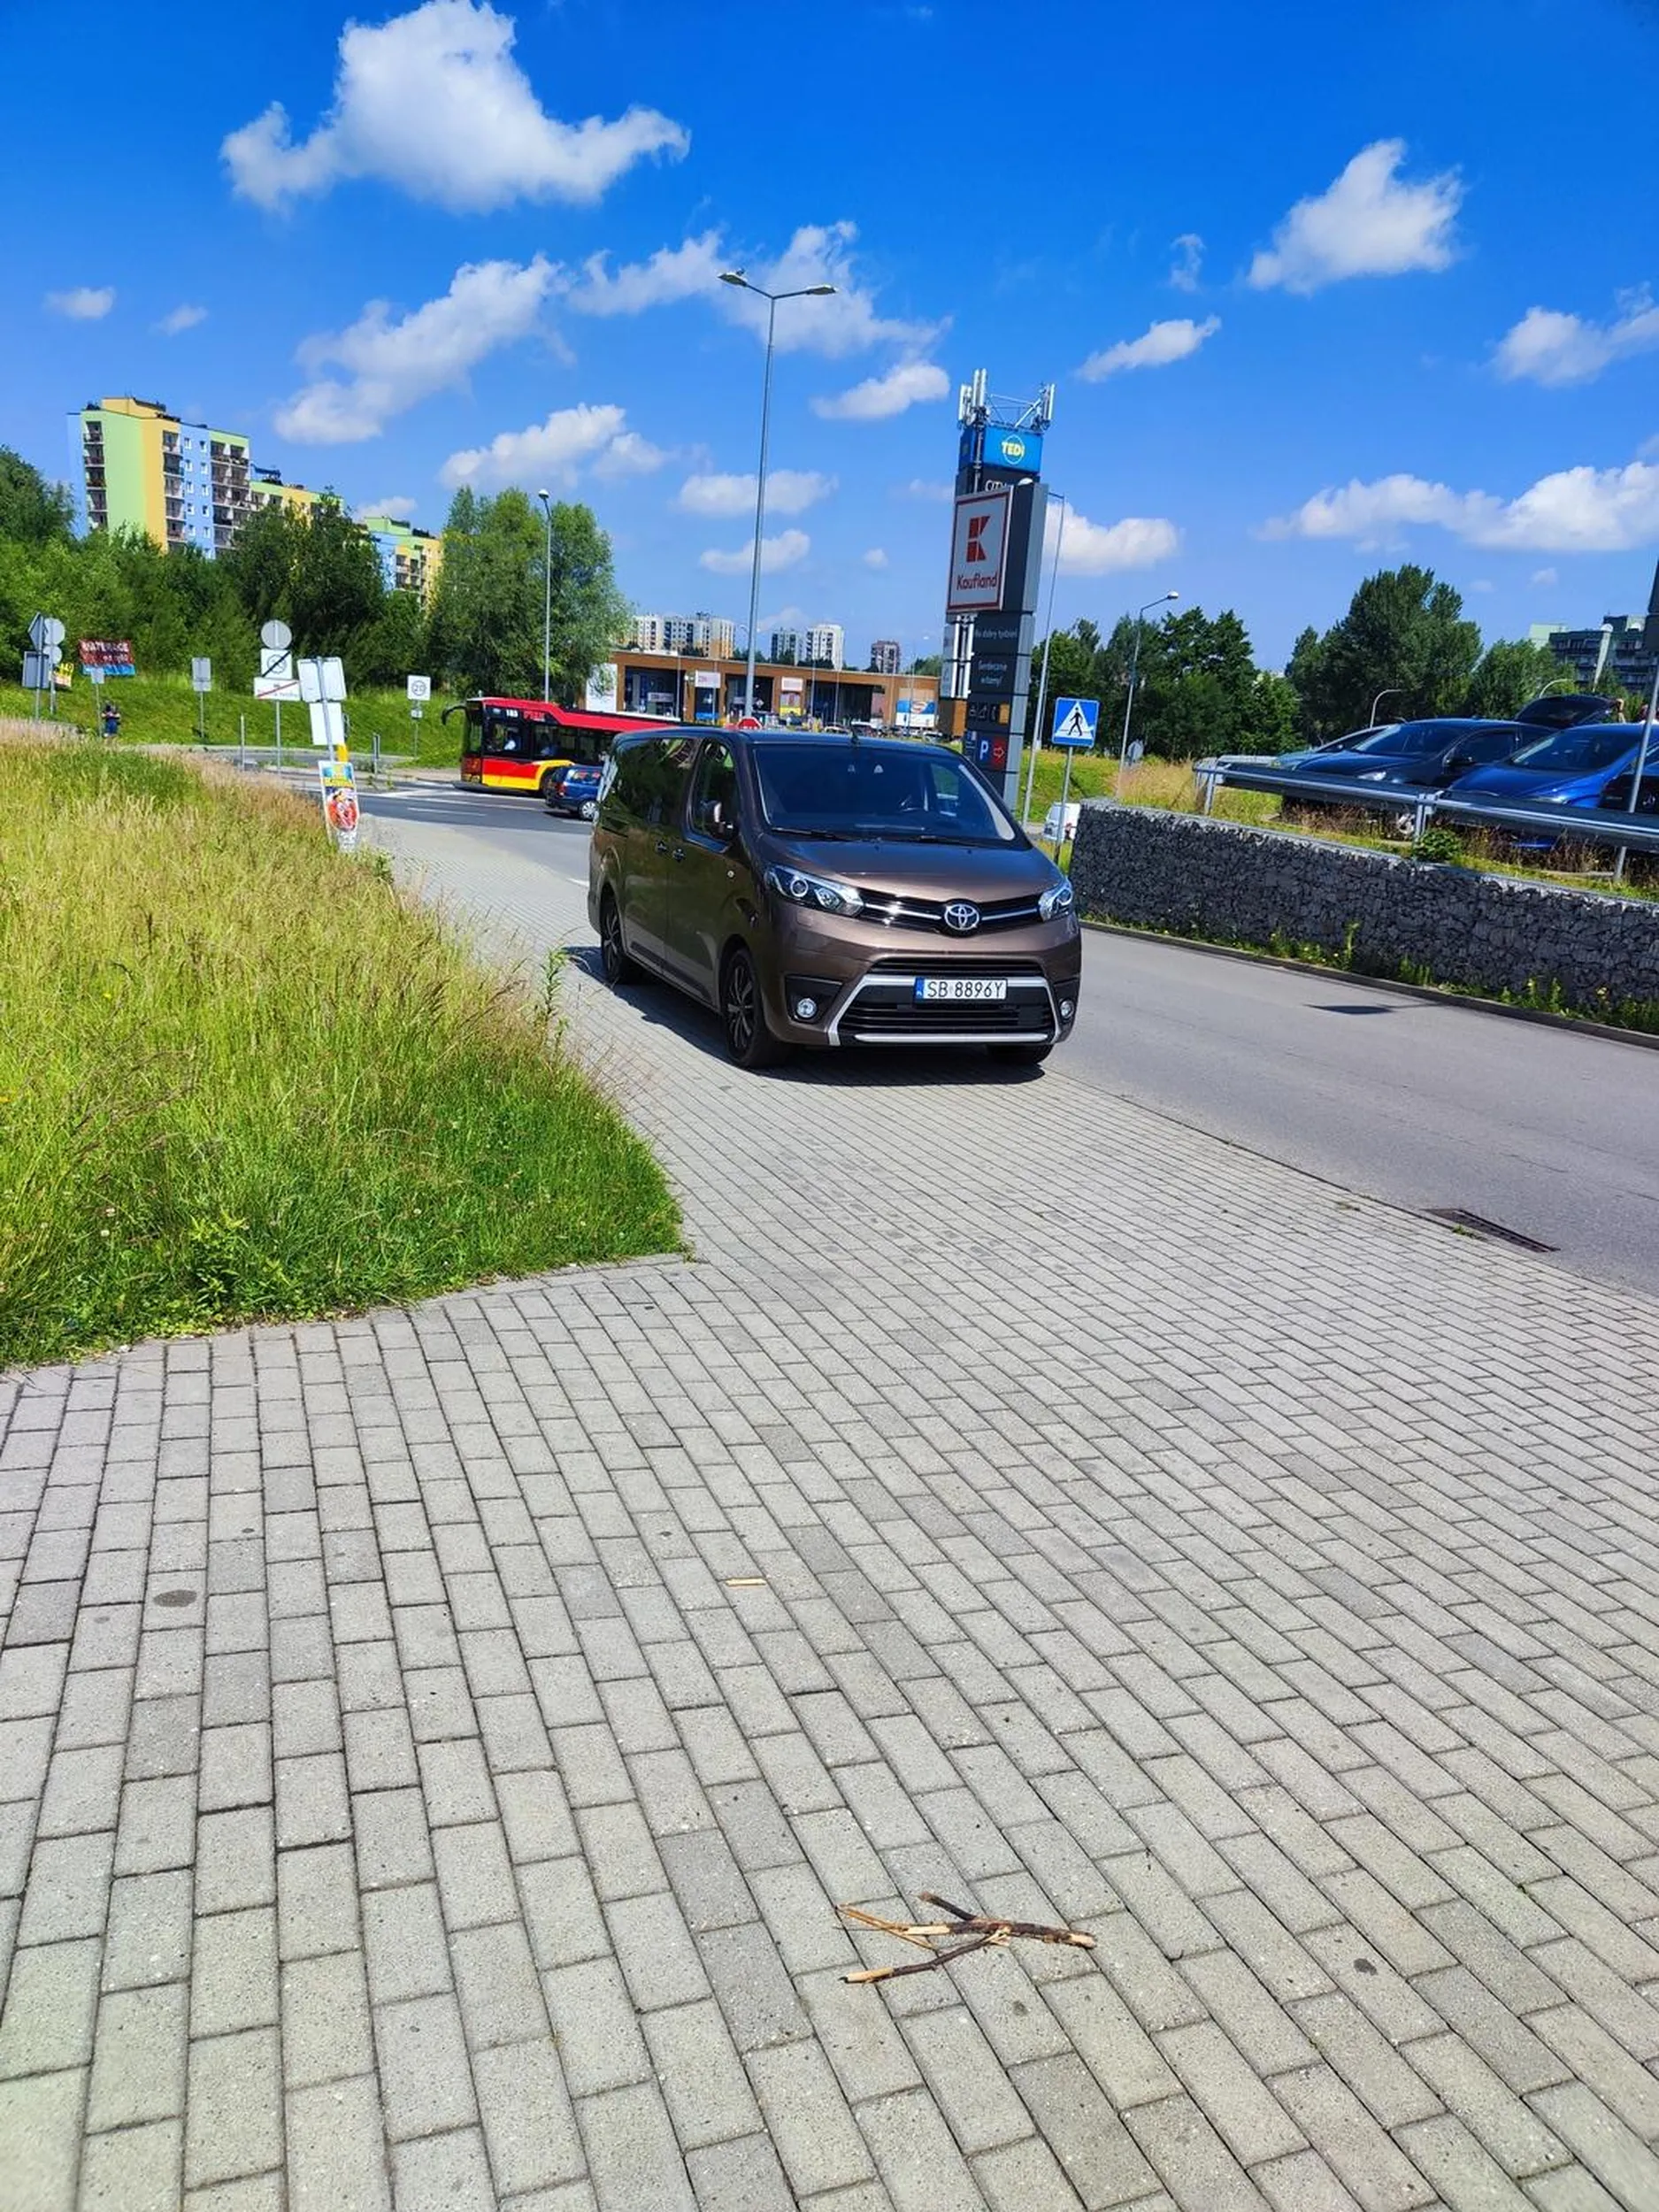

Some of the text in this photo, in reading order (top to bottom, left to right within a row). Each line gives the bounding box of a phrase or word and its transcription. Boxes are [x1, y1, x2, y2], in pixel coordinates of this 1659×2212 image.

[965, 515, 991, 563] K
[956, 571, 998, 591] Kaufland
[979, 740, 989, 760] P
[927, 980, 1003, 998] SB 8896Y
